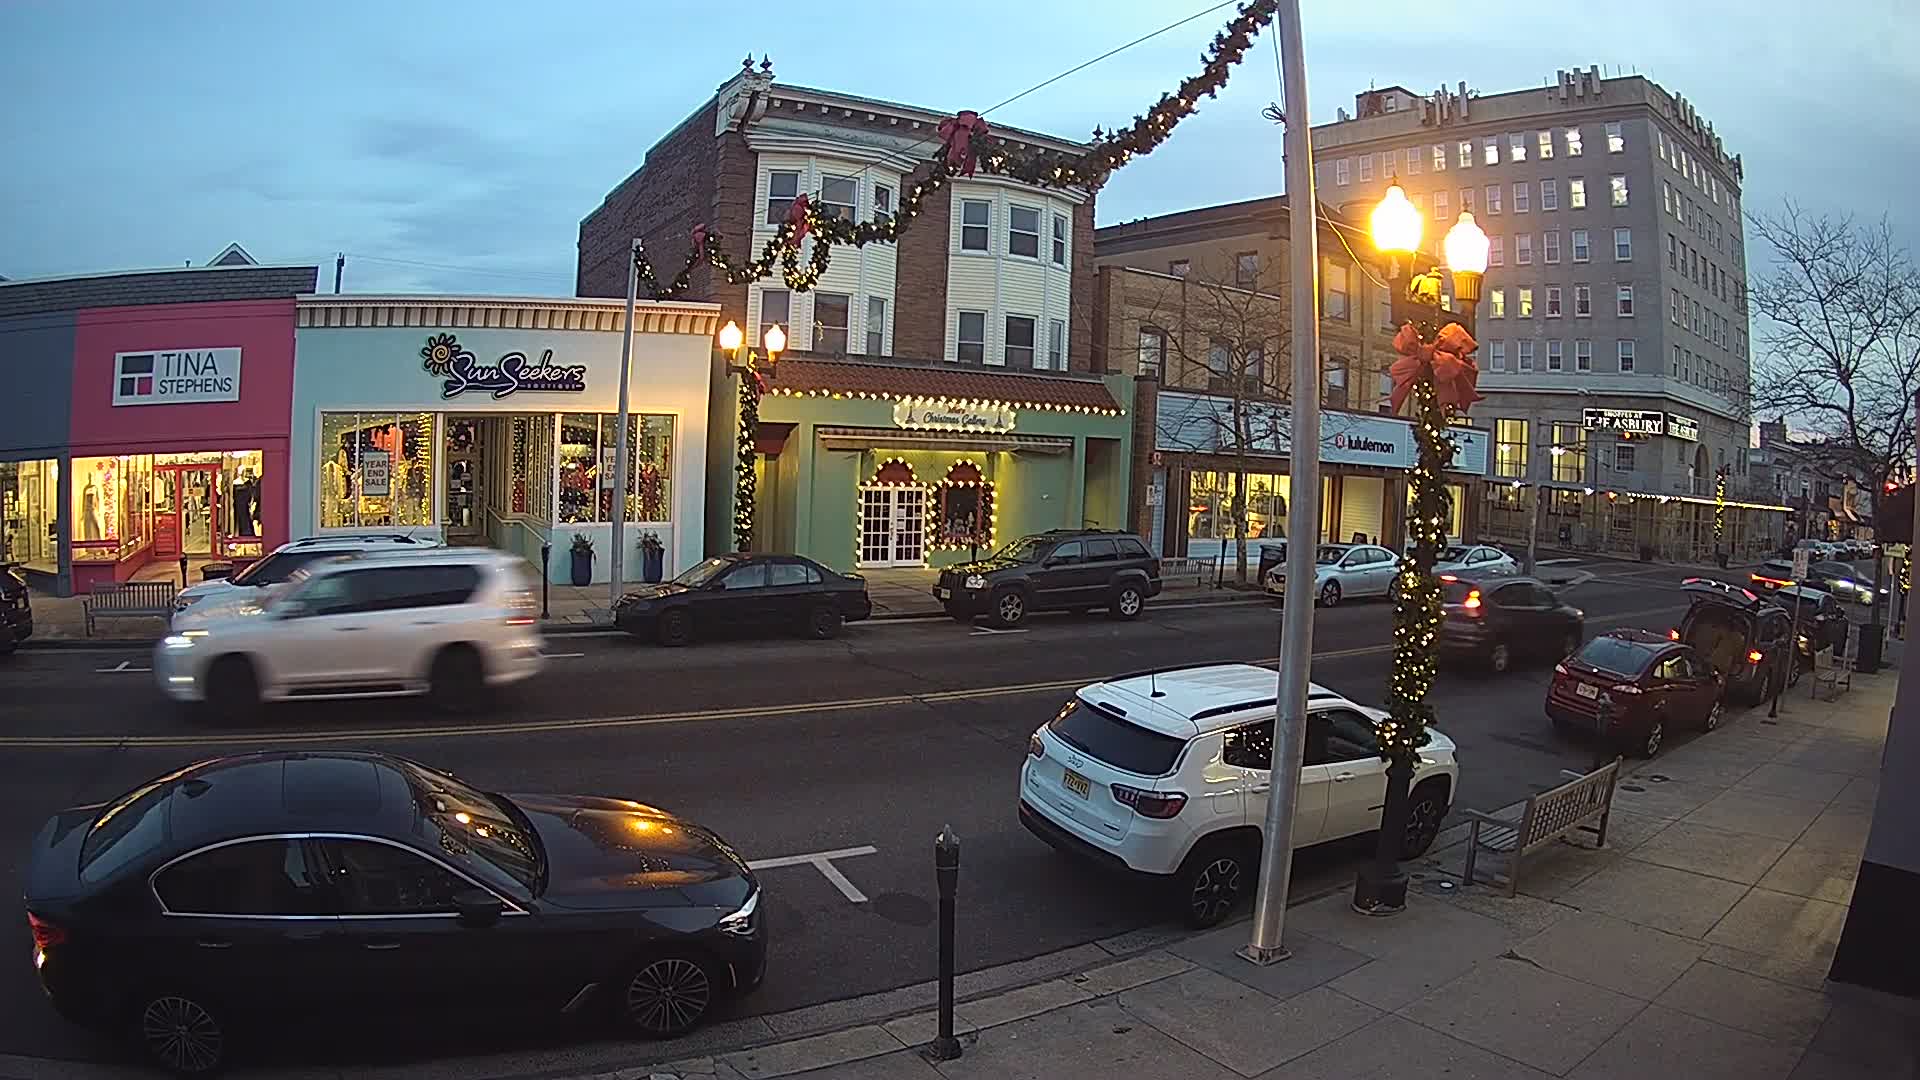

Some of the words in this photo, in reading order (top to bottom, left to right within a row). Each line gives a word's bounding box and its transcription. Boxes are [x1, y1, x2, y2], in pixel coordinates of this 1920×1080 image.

[161, 351, 218, 377] TINA
[445, 353, 500, 396] Sun
[497, 349, 584, 396] Seekers
[159, 377, 233, 395] STEPHENS
[1613, 418, 1661, 434] ASBURY
[1347, 435, 1395, 454] lululemon
[365, 460, 387, 468] YEAR
[367, 469, 385, 477] END
